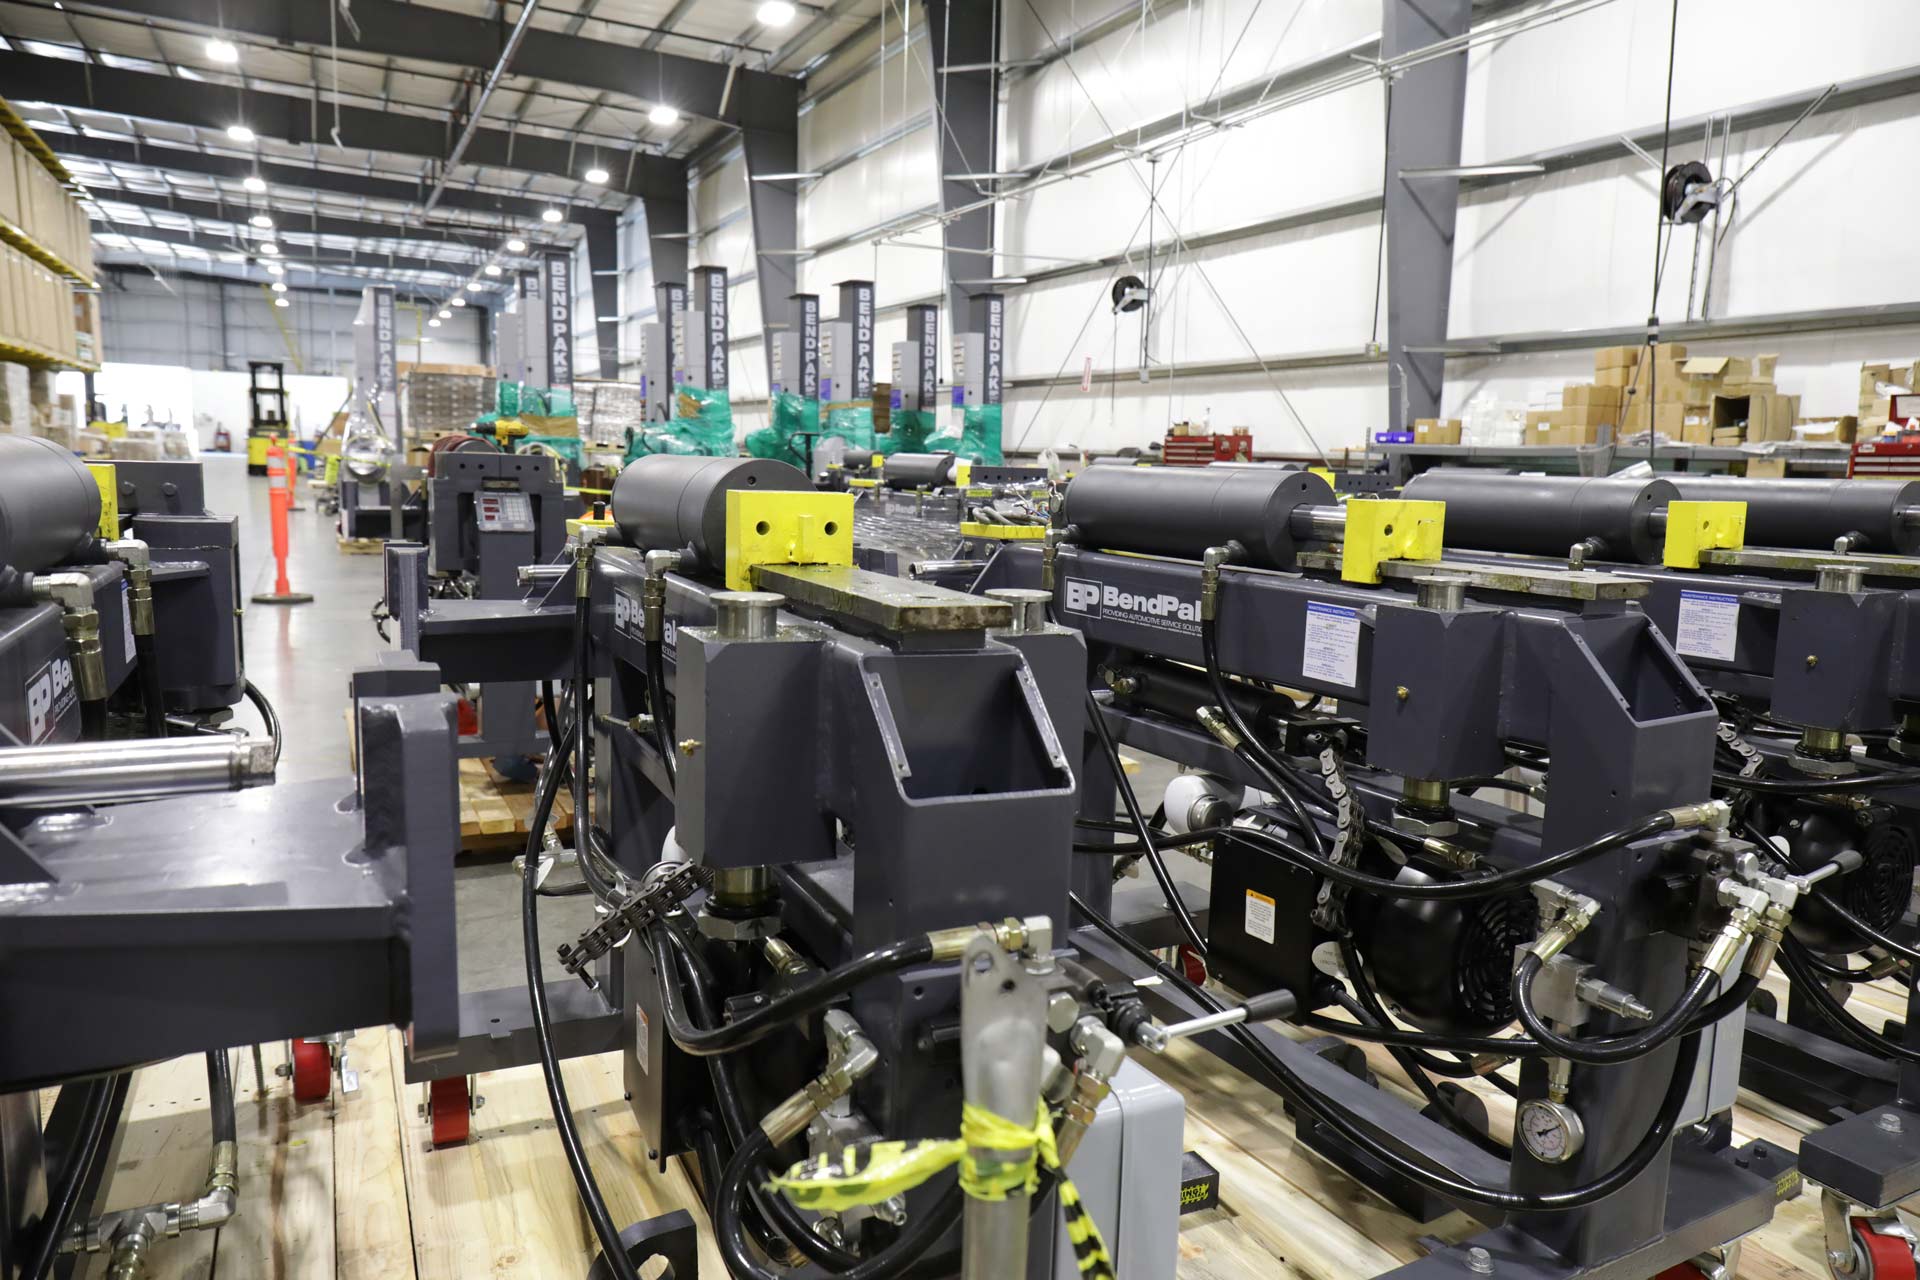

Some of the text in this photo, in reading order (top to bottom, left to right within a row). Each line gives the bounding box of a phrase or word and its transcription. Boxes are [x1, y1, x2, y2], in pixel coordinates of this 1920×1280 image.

[378, 294, 392, 377] BENDPAK
[551, 261, 568, 366] BENDPAK
[711, 274, 725, 373] BENDPAK
[805, 301, 816, 386] BENDPAK
[858, 288, 871, 382] BENDPAK
[924, 311, 935, 393] BENDPAK
[989, 301, 1002, 390] BENDPAK
[1066, 581, 1100, 612] BP
[1129, 614, 1160, 625] AUTOMOTIVE
[1160, 619, 1182, 629] SERVICE
